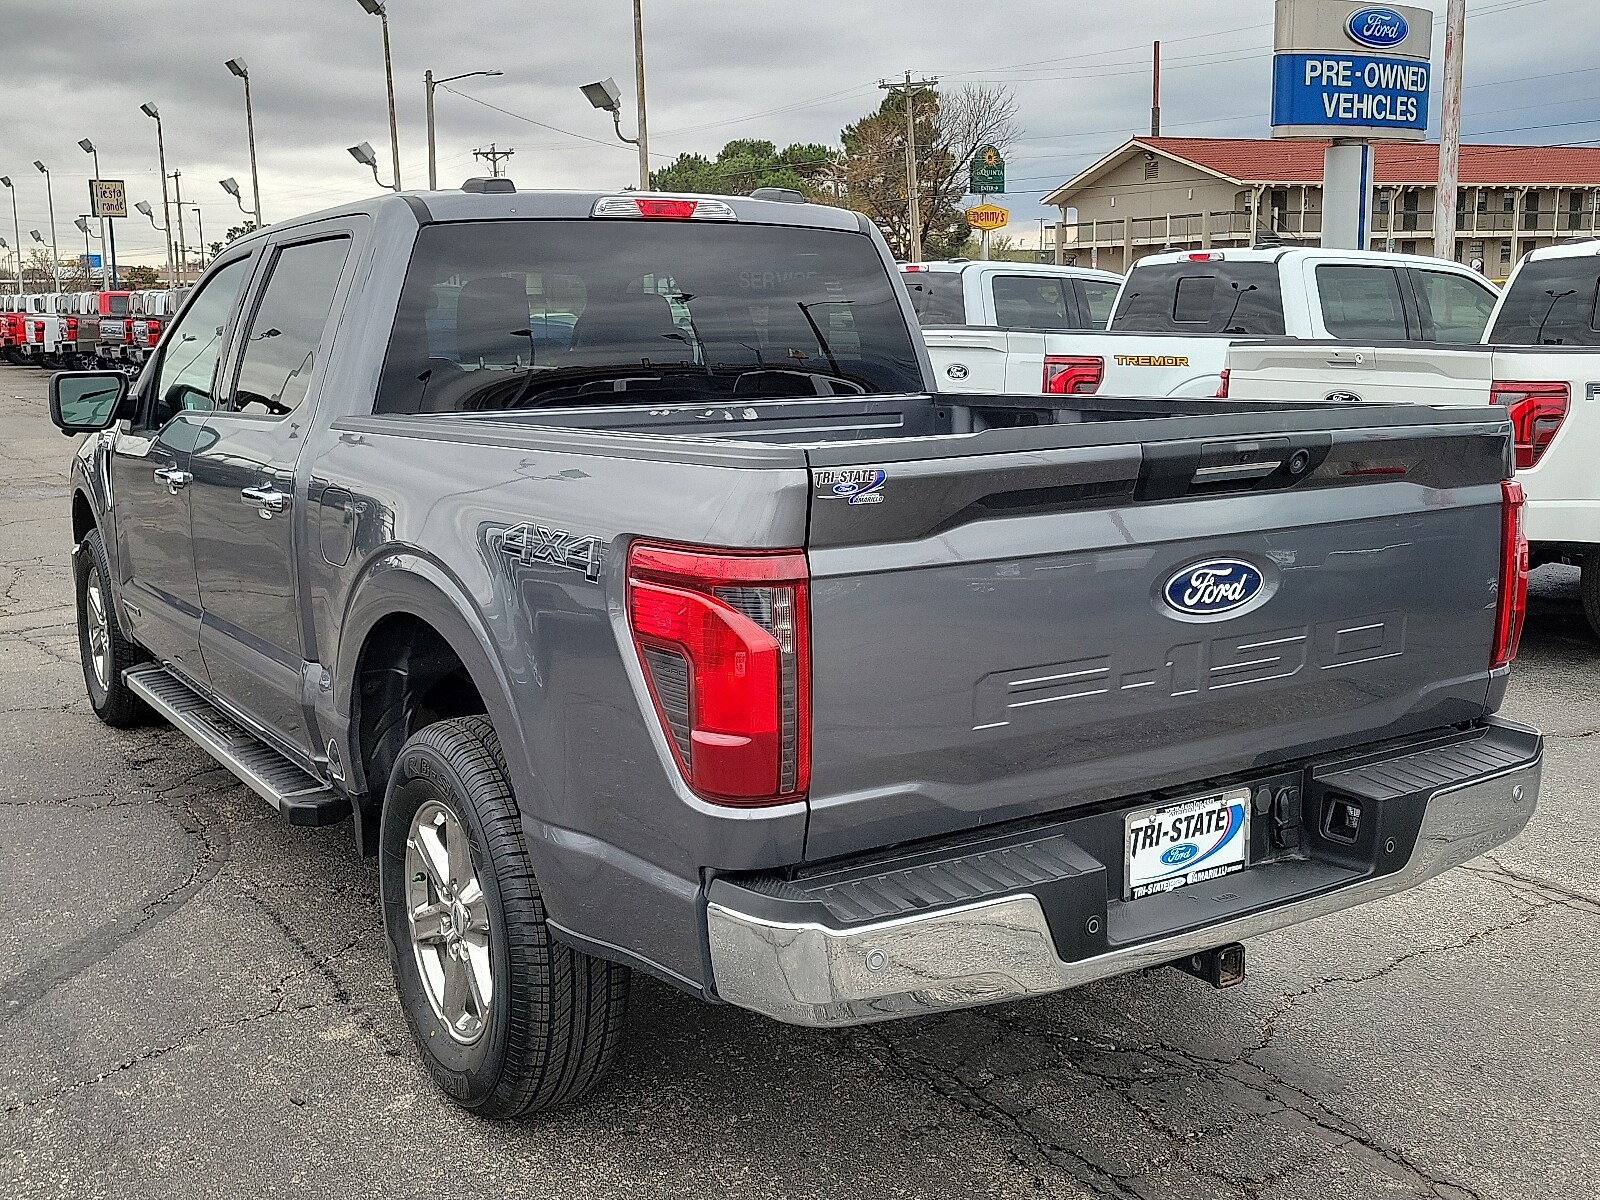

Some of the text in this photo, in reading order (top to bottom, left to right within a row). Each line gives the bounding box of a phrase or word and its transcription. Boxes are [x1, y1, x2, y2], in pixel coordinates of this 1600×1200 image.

[1363, 14, 1399, 39] Ford
[1322, 93, 1417, 121] VEHICLES
[1114, 355, 1190, 367] TREMOR
[814, 470, 876, 488] TRI-STATE
[1183, 567, 1247, 607] Ford
[972, 609, 1407, 730] F-150
[1131, 807, 1226, 859] TRI-STATE
[1167, 846, 1191, 863] Ford
